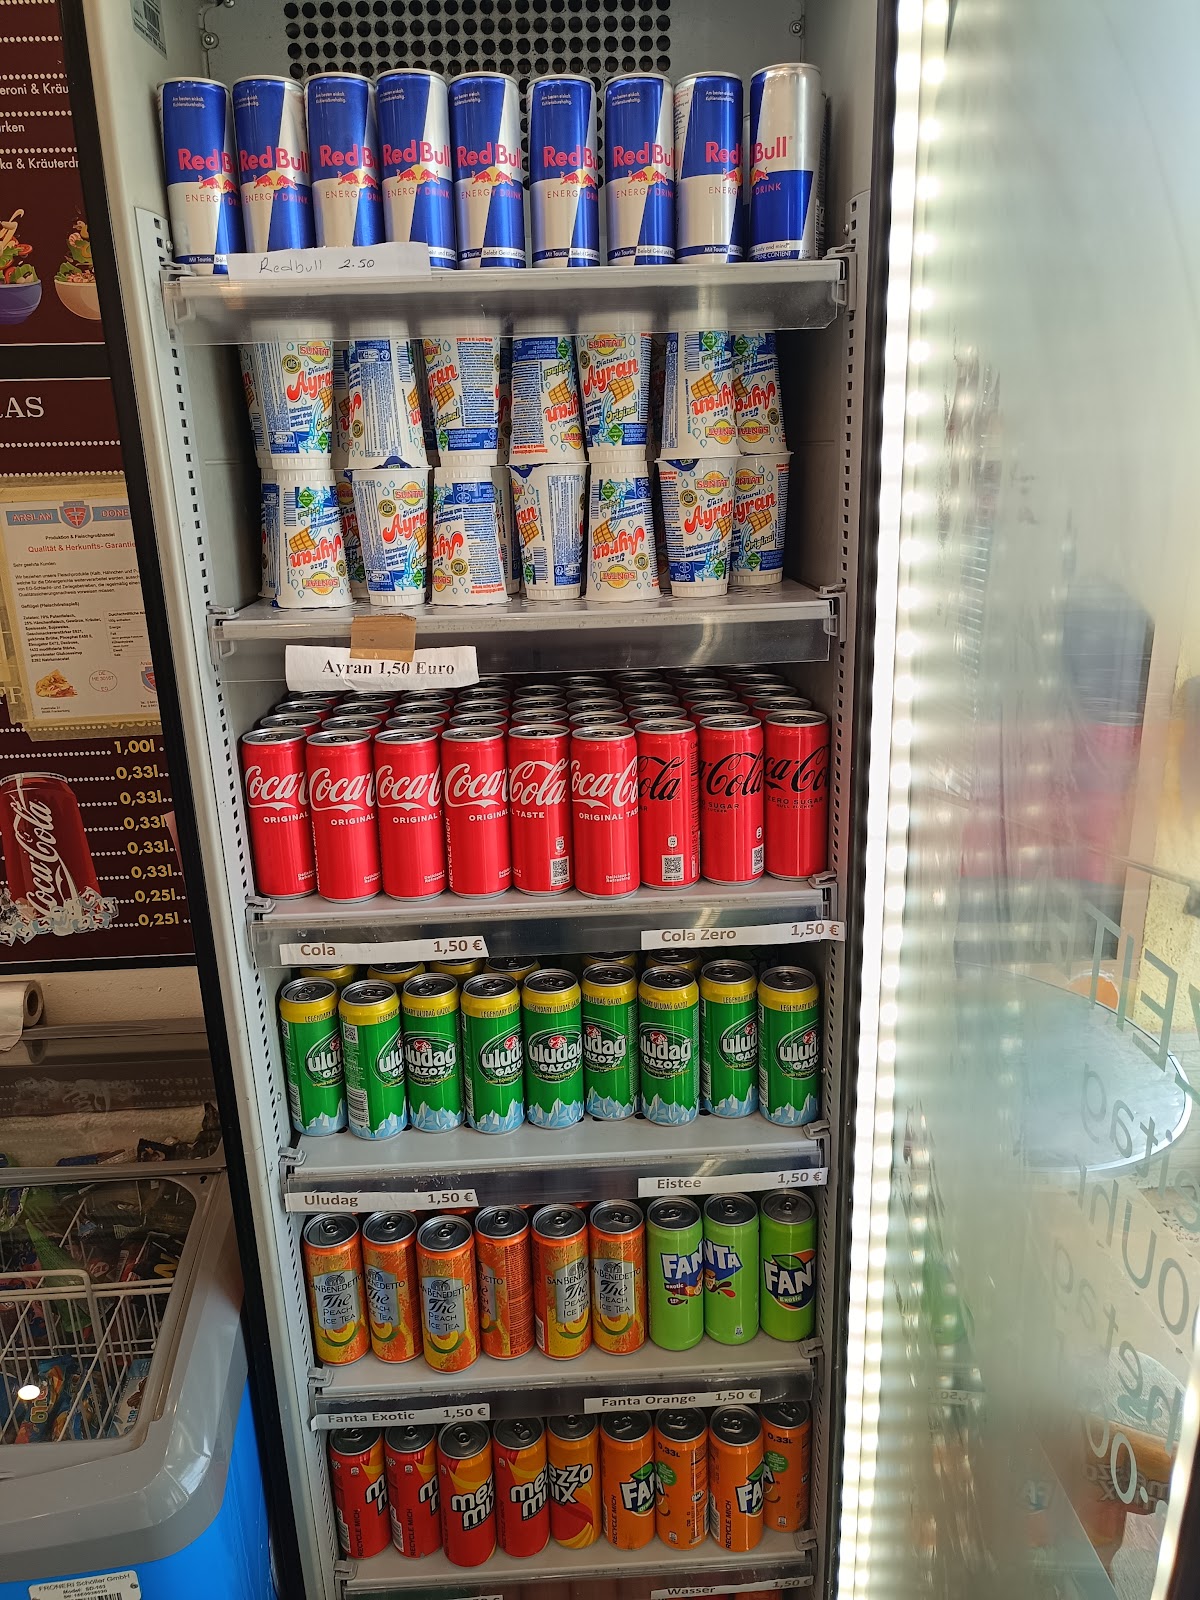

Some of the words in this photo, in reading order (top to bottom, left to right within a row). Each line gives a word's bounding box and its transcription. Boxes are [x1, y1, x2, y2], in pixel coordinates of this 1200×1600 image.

[31, 84, 40, 95] &
[320, 144, 358, 168] Red
[383, 140, 416, 167] Red
[420, 141, 450, 168] Bull
[457, 142, 492, 168] Red
[543, 146, 580, 168] Red
[613, 142, 649, 168] Red
[705, 141, 738, 164] Red
[753, 136, 787, 164] Bull
[17, 158, 25, 170] &
[178, 149, 219, 171] Red
[240, 146, 273, 171] Red
[276, 147, 308, 174] Bull
[756, 182, 781, 196] DRINK
[258, 256, 323, 274] Redbull
[337, 258, 375, 270] 2.50
[583, 358, 639, 397] Ayran
[0, 396, 45, 419] AS
[12, 512, 53, 522] ARSLAN
[28, 545, 56, 553] Qualität
[290, 534, 342, 568] Ayran
[592, 526, 646, 561] Ayran
[322, 658, 373, 678] Ayran
[379, 661, 410, 677] 1,50
[416, 661, 455, 675] Euro
[114, 739, 155, 755] 1,00l
[116, 765, 158, 781] 0,33l
[120, 790, 162, 806] 0,33l
[708, 802, 739, 810] SUGAR
[124, 815, 166, 831] 0,33l
[392, 812, 438, 824] ORIGINAL
[516, 811, 545, 819] TASTE
[579, 812, 623, 821] ORIGINAL
[127, 840, 168, 856] 0,33l
[131, 864, 172, 880] 0,33l
[135, 888, 176, 904] 0,25l
[138, 913, 179, 927] 0,25l
[661, 929, 696, 943] Cola
[700, 929, 737, 941] Zero
[790, 922, 825, 938] 1,50
[829, 924, 840, 935] €
[300, 944, 336, 957] Cola
[433, 939, 468, 954] 1,50
[472, 939, 483, 951] €
[779, 1036, 818, 1062] ulud
[408, 1064, 446, 1076] GAZOZ
[539, 1060, 579, 1072] GAZOZ
[643, 1056, 680, 1069] GAZOZ
[657, 1178, 702, 1190] Eistee
[777, 1172, 809, 1184] 1,50
[813, 1171, 822, 1181] €
[304, 1193, 358, 1207] Uludag
[427, 1192, 459, 1204] 1,50
[464, 1191, 474, 1202] €
[323, 1305, 353, 1316] PEACH
[379, 1312, 394, 1322] TEA
[428, 1313, 457, 1322] PEACH
[563, 1308, 577, 1318] ICE
[614, 1305, 630, 1314] TEA
[323, 1316, 338, 1325] ICE
[340, 1313, 356, 1324] TEA
[428, 1320, 442, 1330] ICE
[444, 1323, 460, 1332] TEA
[602, 1397, 641, 1407] Fanta
[645, 1394, 696, 1405] Orange
[715, 1391, 745, 1401] 1,50
[749, 1390, 758, 1399] €
[328, 1414, 368, 1424] Fanta
[372, 1411, 415, 1423] Exotic
[443, 1408, 474, 1419] 1,50
[477, 1407, 487, 1416] €
[667, 1586, 716, 1596] Wasser
[773, 1579, 800, 1588] 1,50
